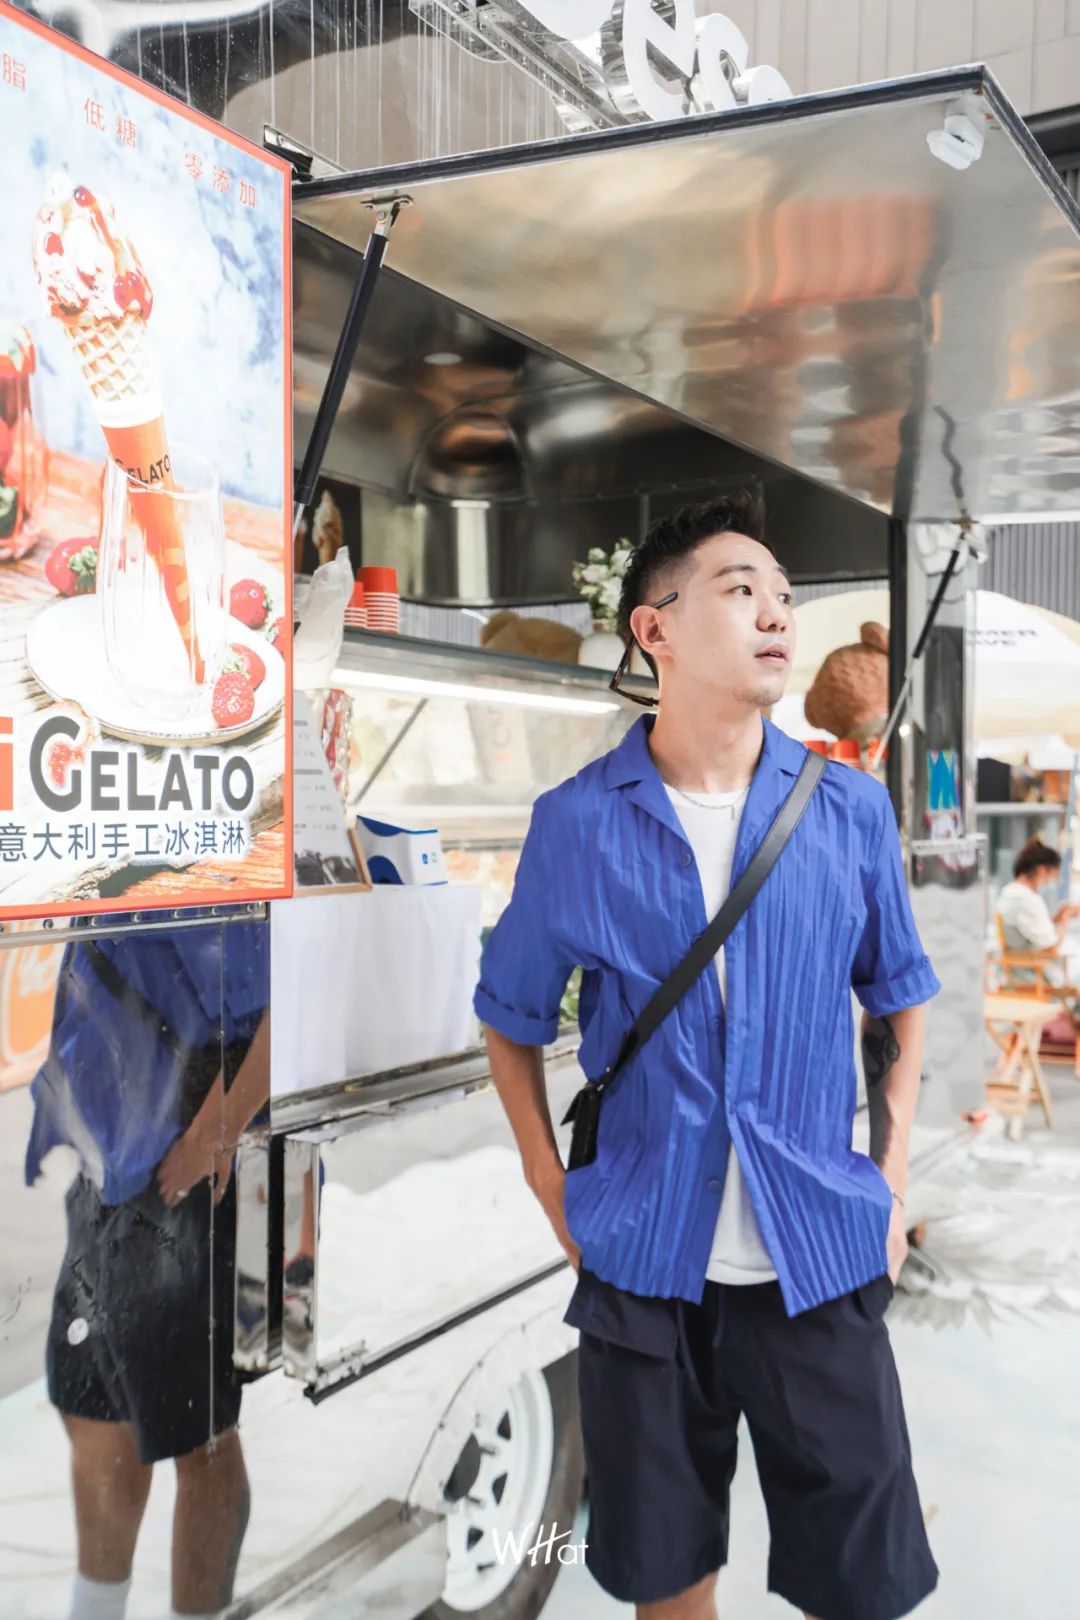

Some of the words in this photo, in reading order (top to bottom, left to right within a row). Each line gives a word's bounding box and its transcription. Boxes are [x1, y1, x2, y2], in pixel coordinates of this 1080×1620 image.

[2, 53, 27, 91] 脂
[83, 98, 137, 148] 低糖
[184, 152, 257, 209] 零添加
[29, 715, 254, 812] GELATO
[0, 820, 245, 862] 意大利手工冰淇淋
